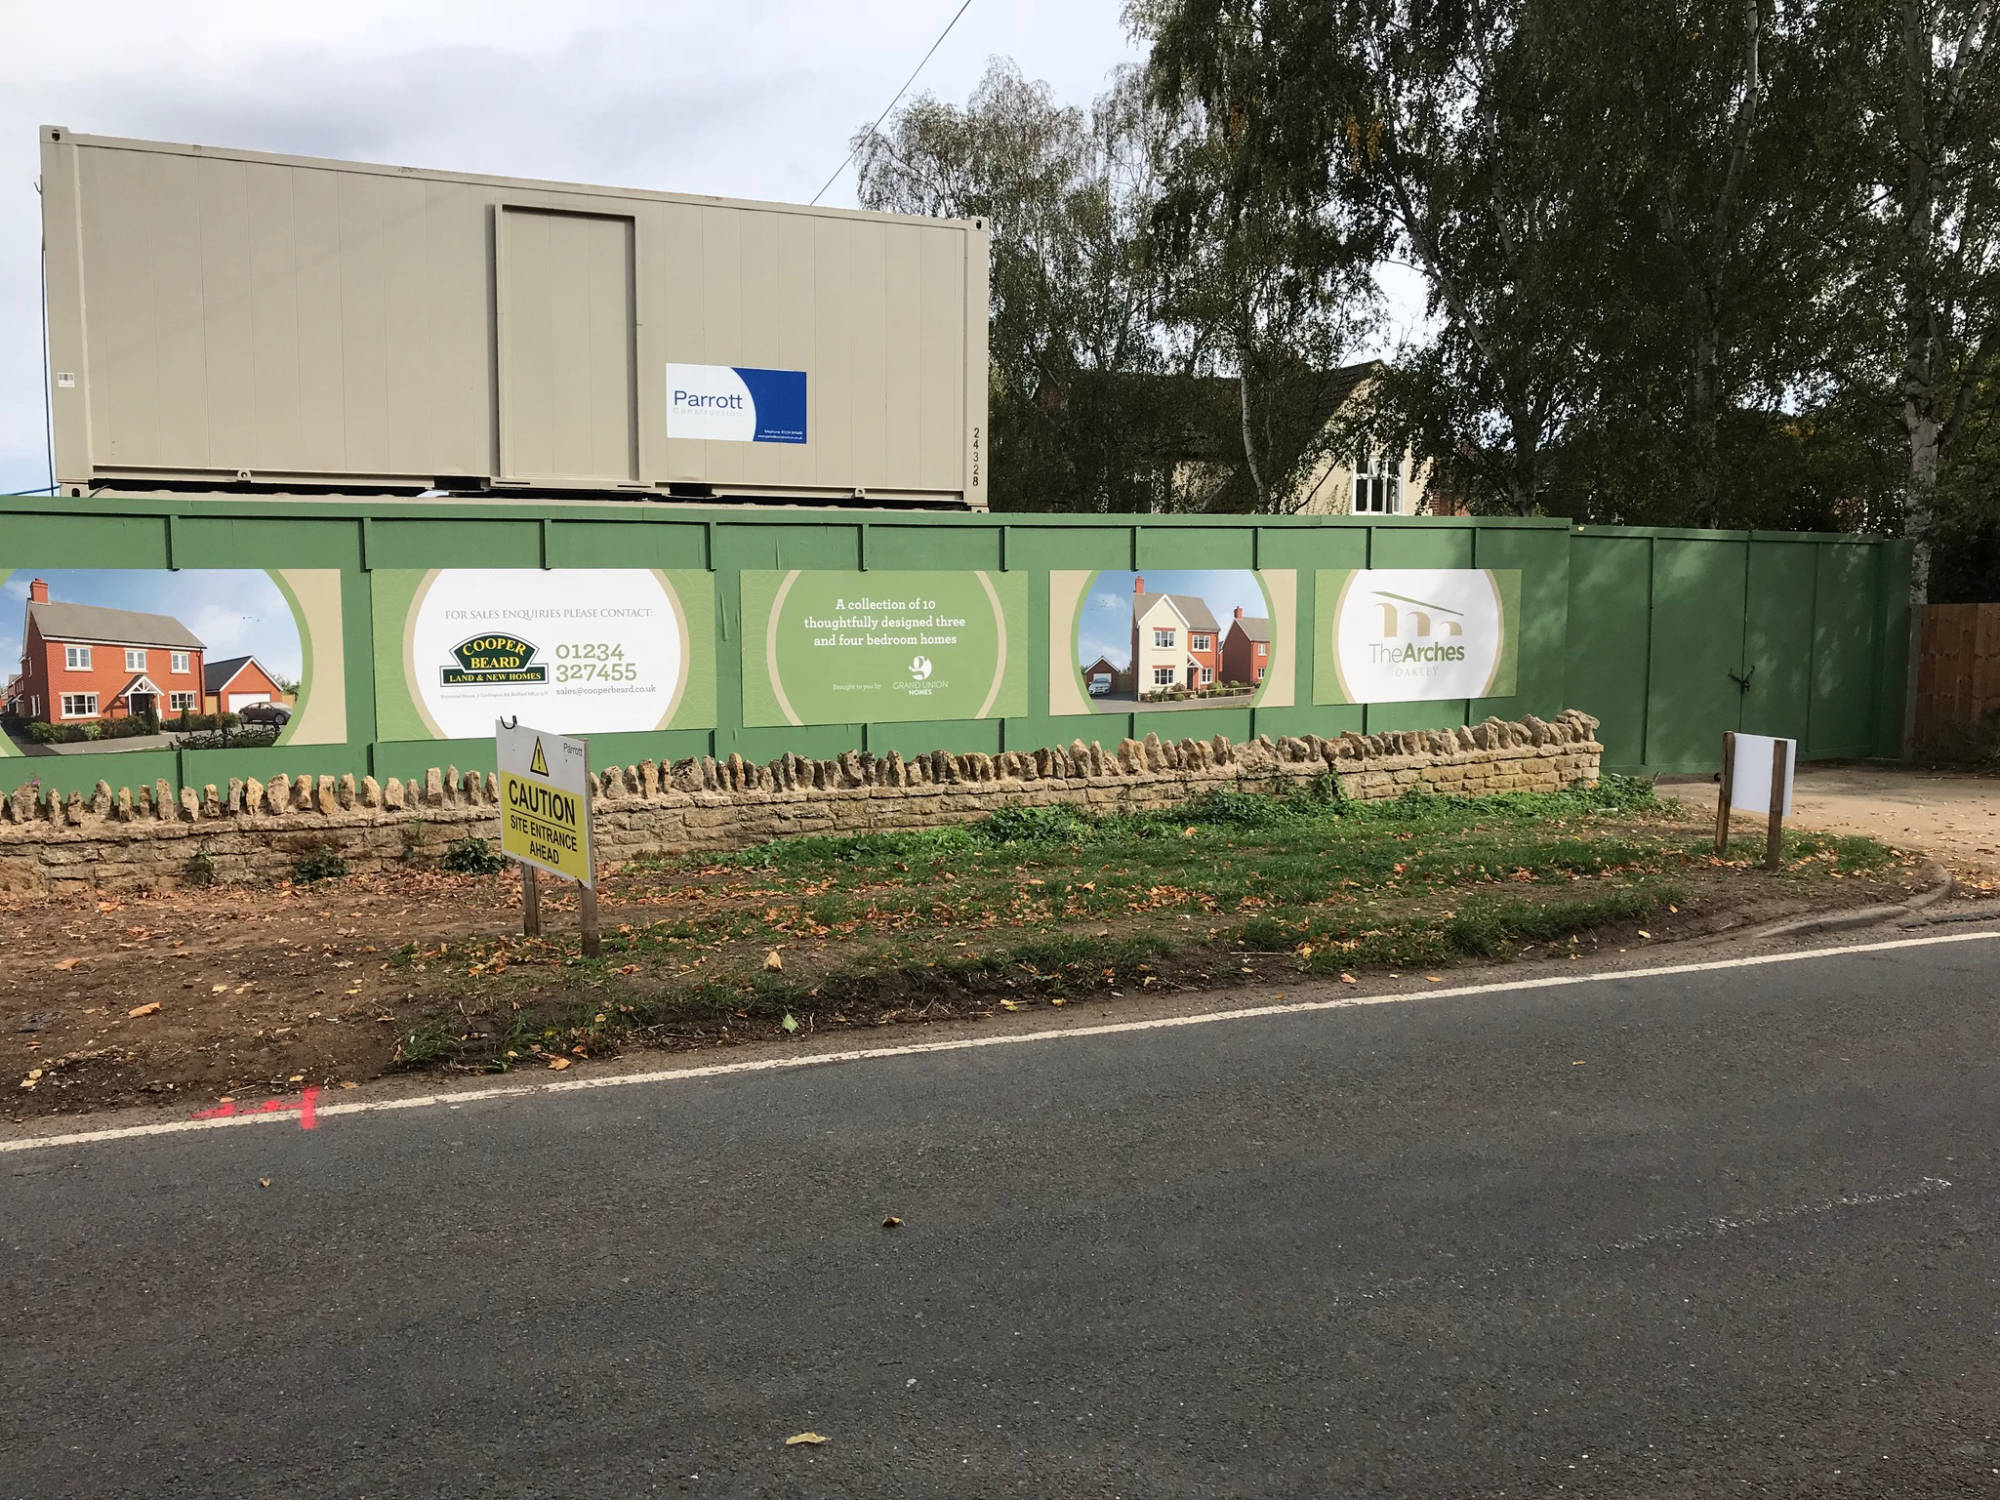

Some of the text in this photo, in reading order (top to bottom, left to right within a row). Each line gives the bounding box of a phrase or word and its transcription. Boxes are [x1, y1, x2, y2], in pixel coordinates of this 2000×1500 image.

[674, 390, 743, 409] Parrott
[972, 427, 980, 487] 24328
[835, 598, 936, 610] A collection of 10
[445, 610, 468, 620] FOR
[470, 610, 500, 619] SALES
[502, 608, 561, 620] ENQUIRIES
[563, 608, 598, 618] PLEASE
[804, 615, 966, 630] thoughtfully designed three
[462, 637, 527, 656] COOPER
[813, 632, 958, 646] and four bedroom homes
[555, 643, 625, 661] 01234
[470, 656, 520, 669] BEARD
[449, 674, 474, 683] LAND
[486, 673, 507, 681] NEW
[509, 672, 541, 680] HOMES
[555, 663, 638, 683] 327455
[1394, 666, 1439, 678] OAKLEY
[555, 684, 656, 696] sales@cooperbeard.co.uk
[892, 680, 949, 690] GRAND UNION
[508, 779, 576, 826] CAUTION
[510, 814, 578, 852] SITE ENTRANCE
[529, 840, 560, 865] AHEAD
